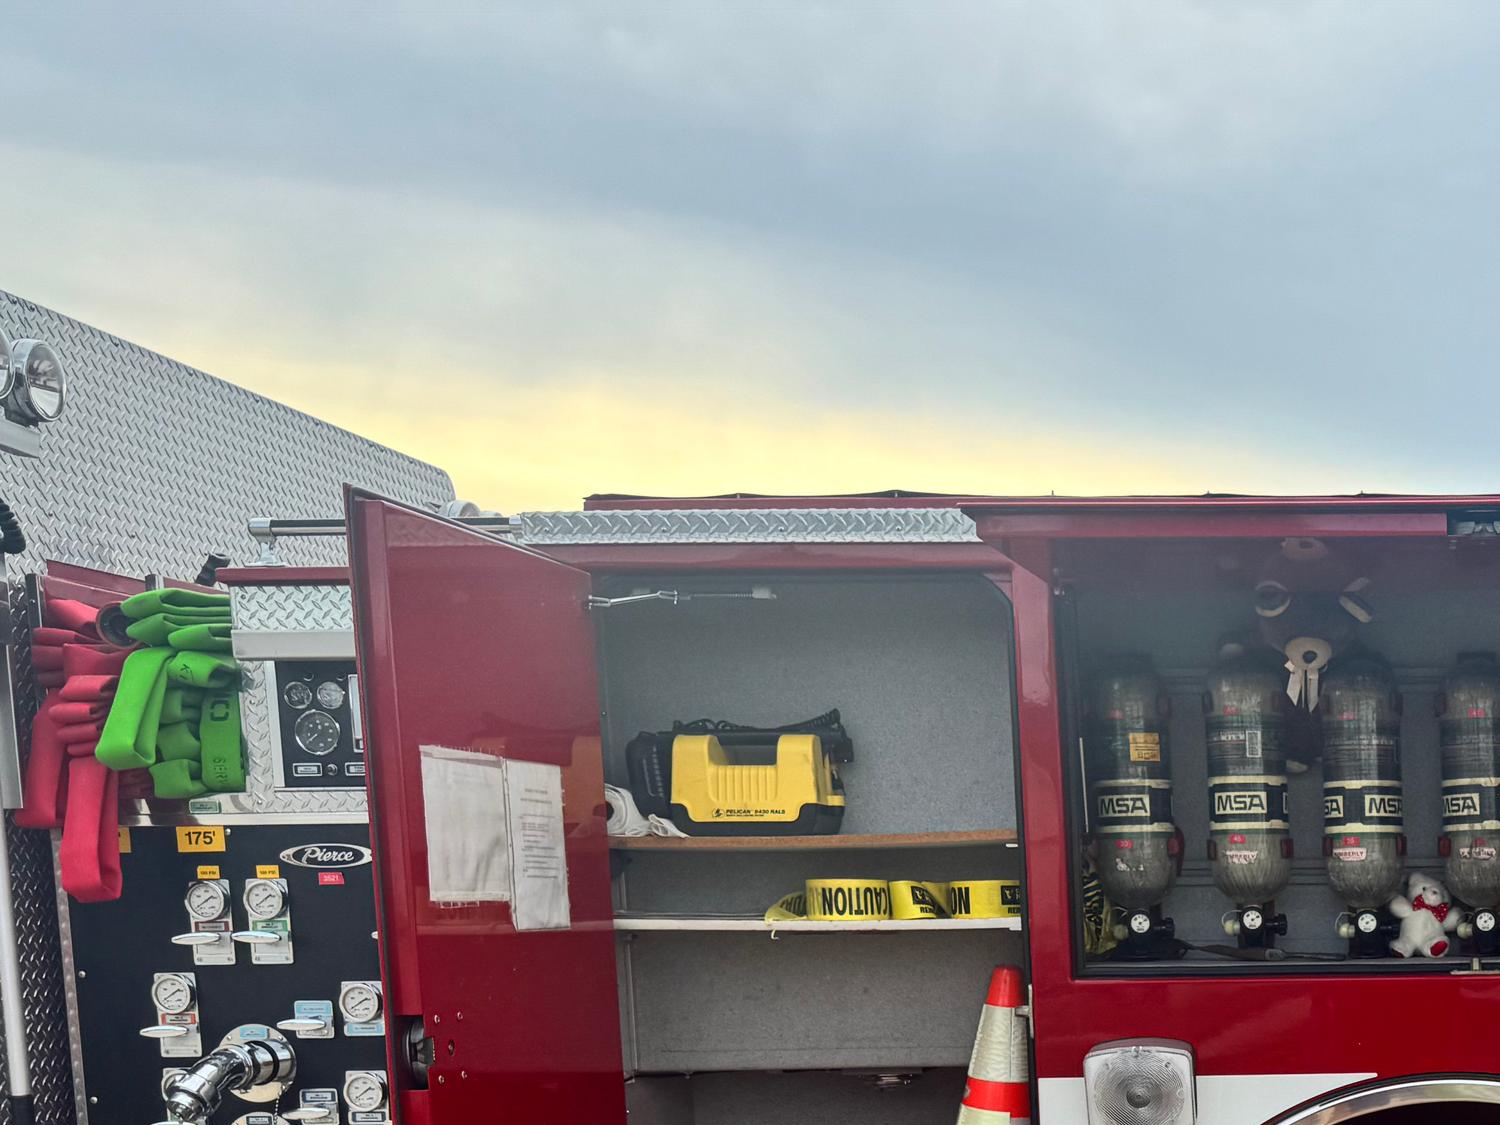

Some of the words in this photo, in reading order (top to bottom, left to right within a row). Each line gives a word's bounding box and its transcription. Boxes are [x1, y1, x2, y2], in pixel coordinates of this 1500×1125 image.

[1100, 797, 1148, 815] MSA
[1217, 794, 1265, 811] MSA
[185, 831, 216, 846] 175'
[302, 847, 354, 864] Pierce
[821, 887, 888, 916] CAUTION
